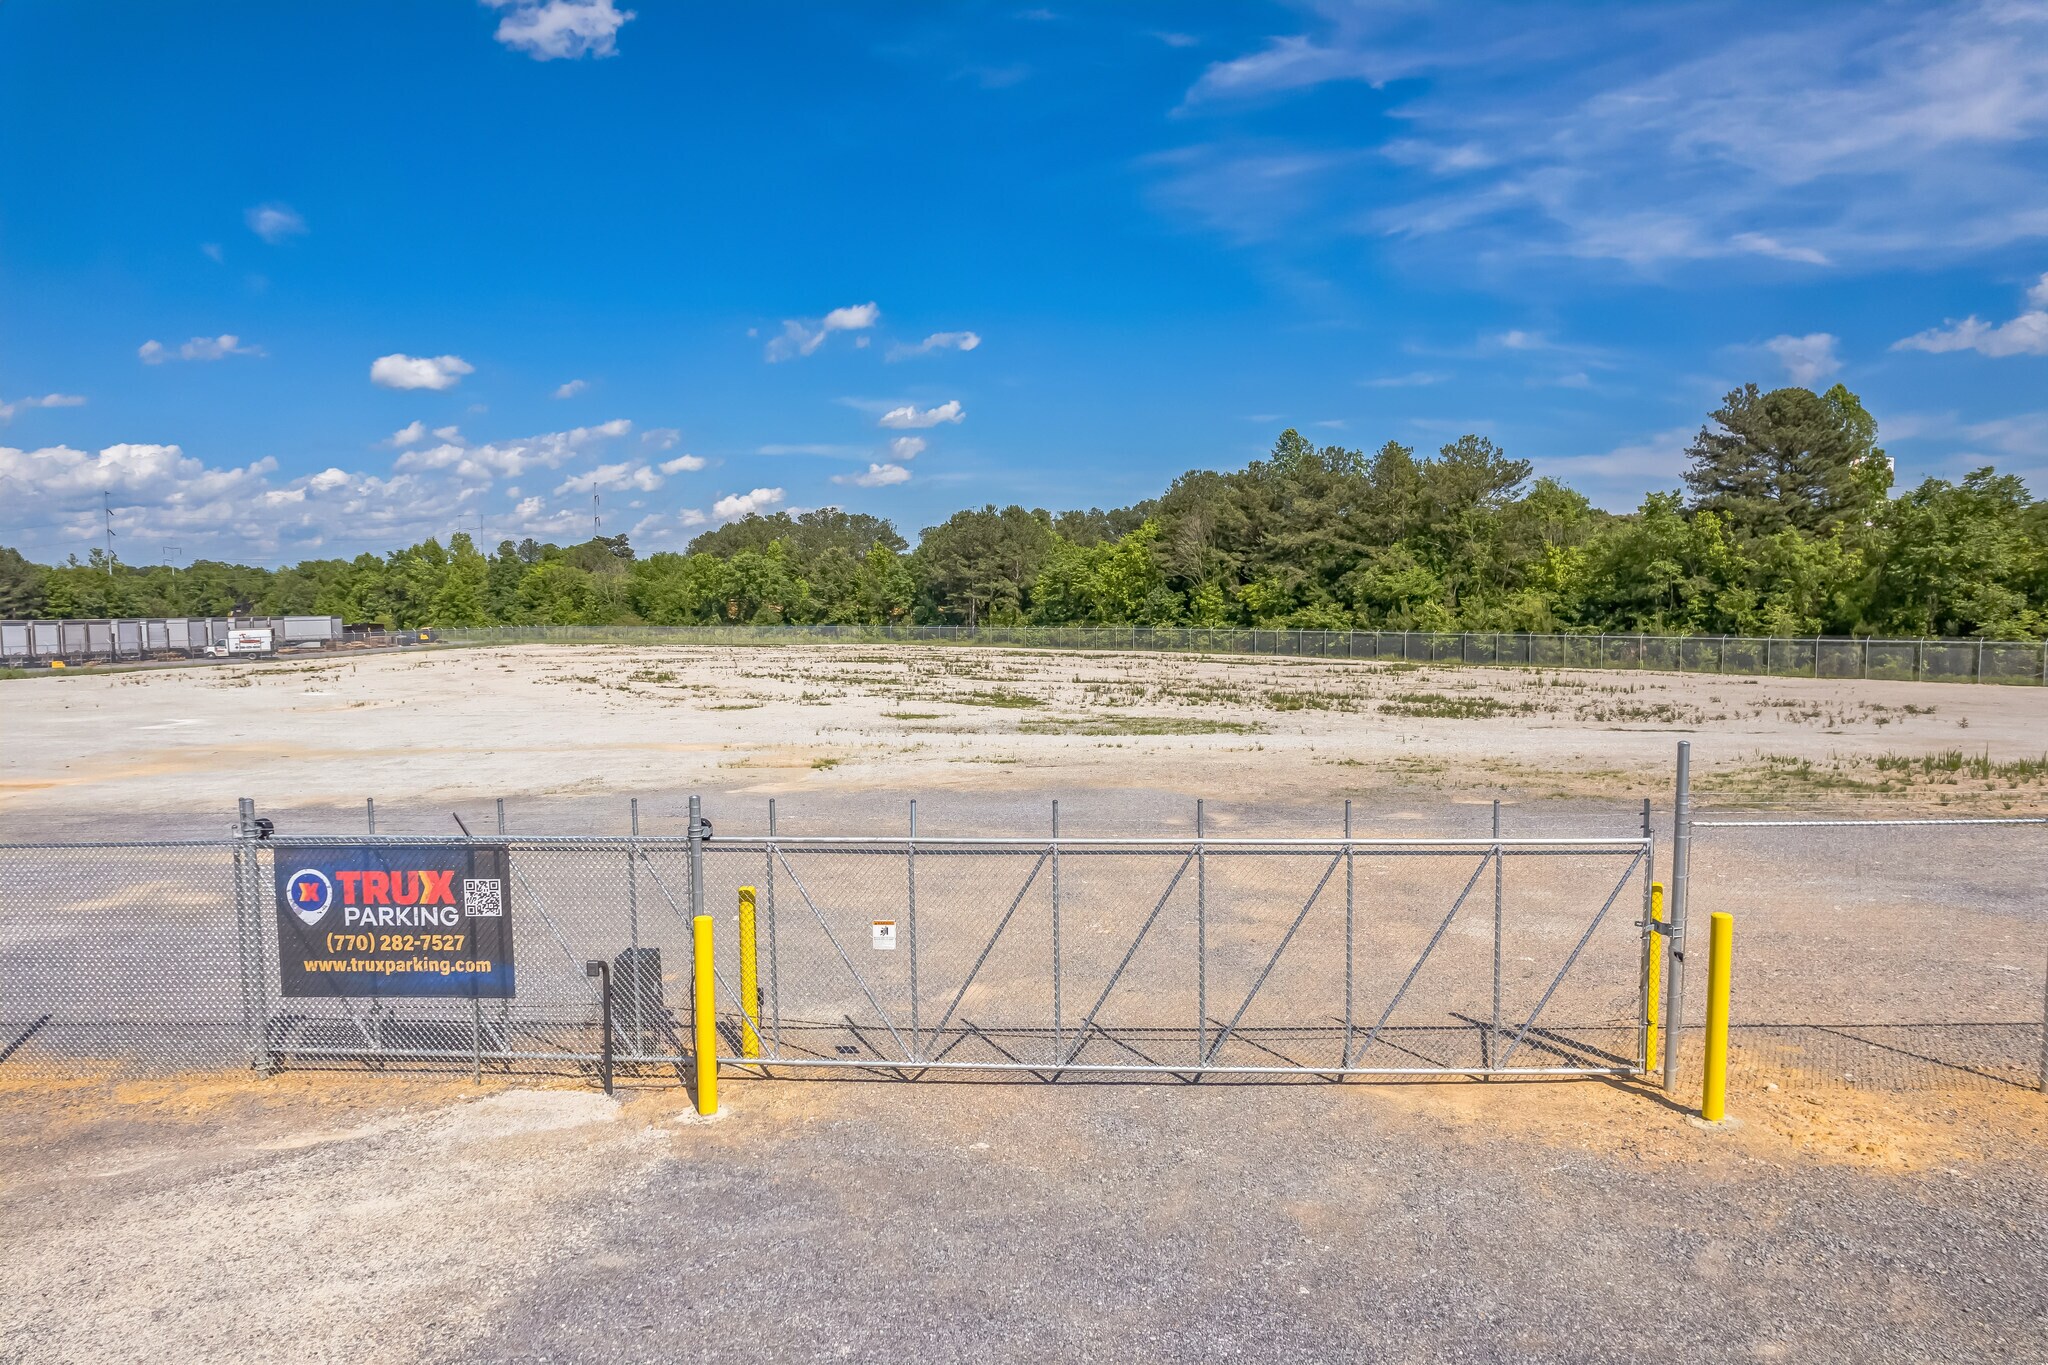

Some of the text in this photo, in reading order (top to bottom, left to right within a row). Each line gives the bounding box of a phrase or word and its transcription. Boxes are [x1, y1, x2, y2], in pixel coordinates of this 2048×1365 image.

[298, 882, 320, 902] X
[335, 870, 457, 906] TRUX
[344, 906, 460, 927] PARKING
[326, 932, 466, 954] (770) 282-7527
[303, 956, 492, 976] www.truxparking.com
